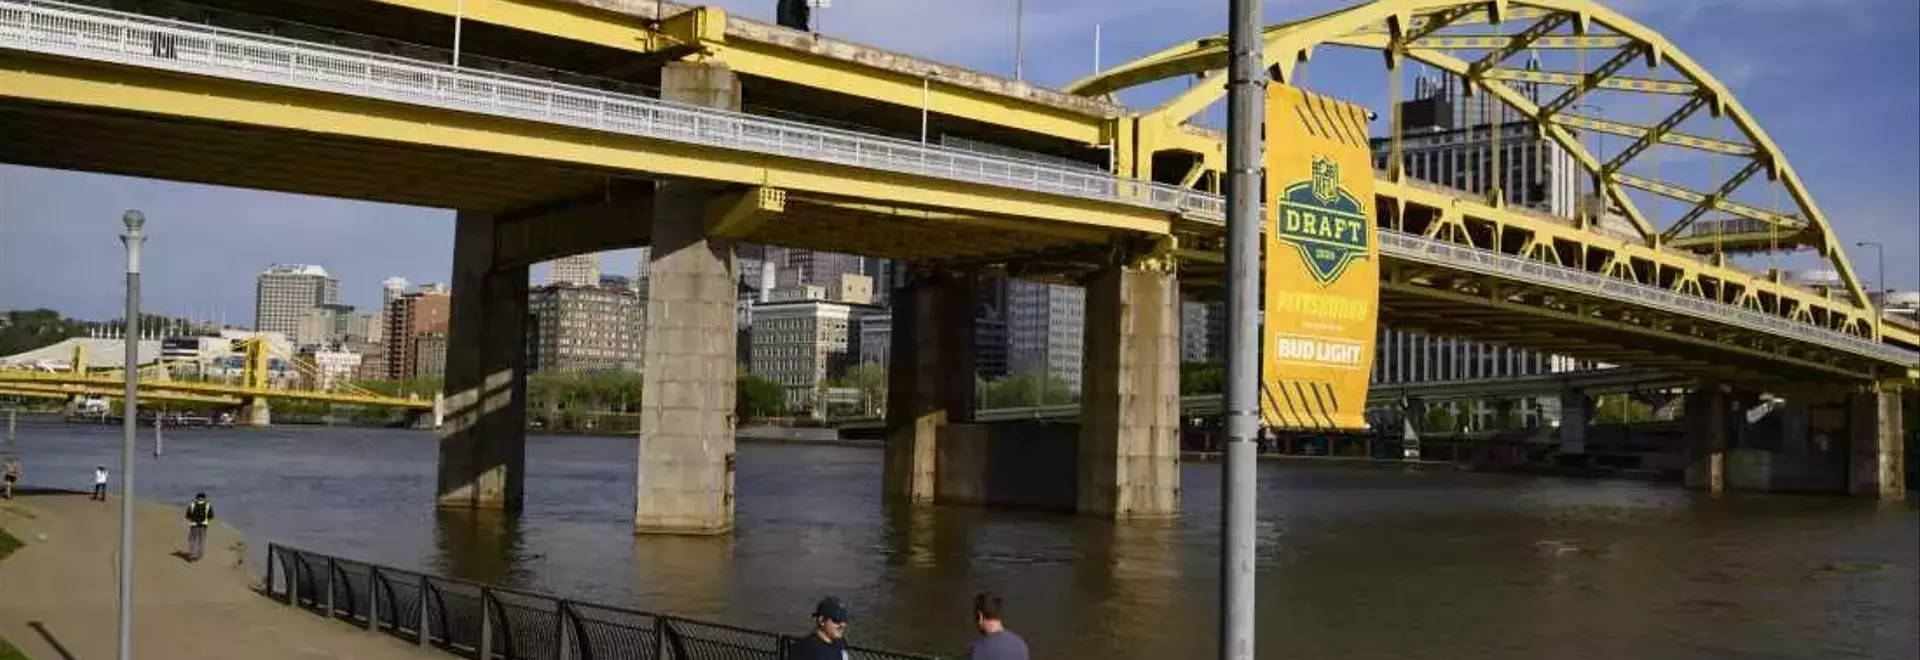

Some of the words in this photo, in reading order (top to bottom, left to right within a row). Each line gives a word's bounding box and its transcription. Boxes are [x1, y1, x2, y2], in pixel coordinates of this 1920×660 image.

[1285, 209, 1361, 242] DRAFT
[1278, 338, 1315, 360] BUD
[1316, 341, 1362, 364] LIGHT
